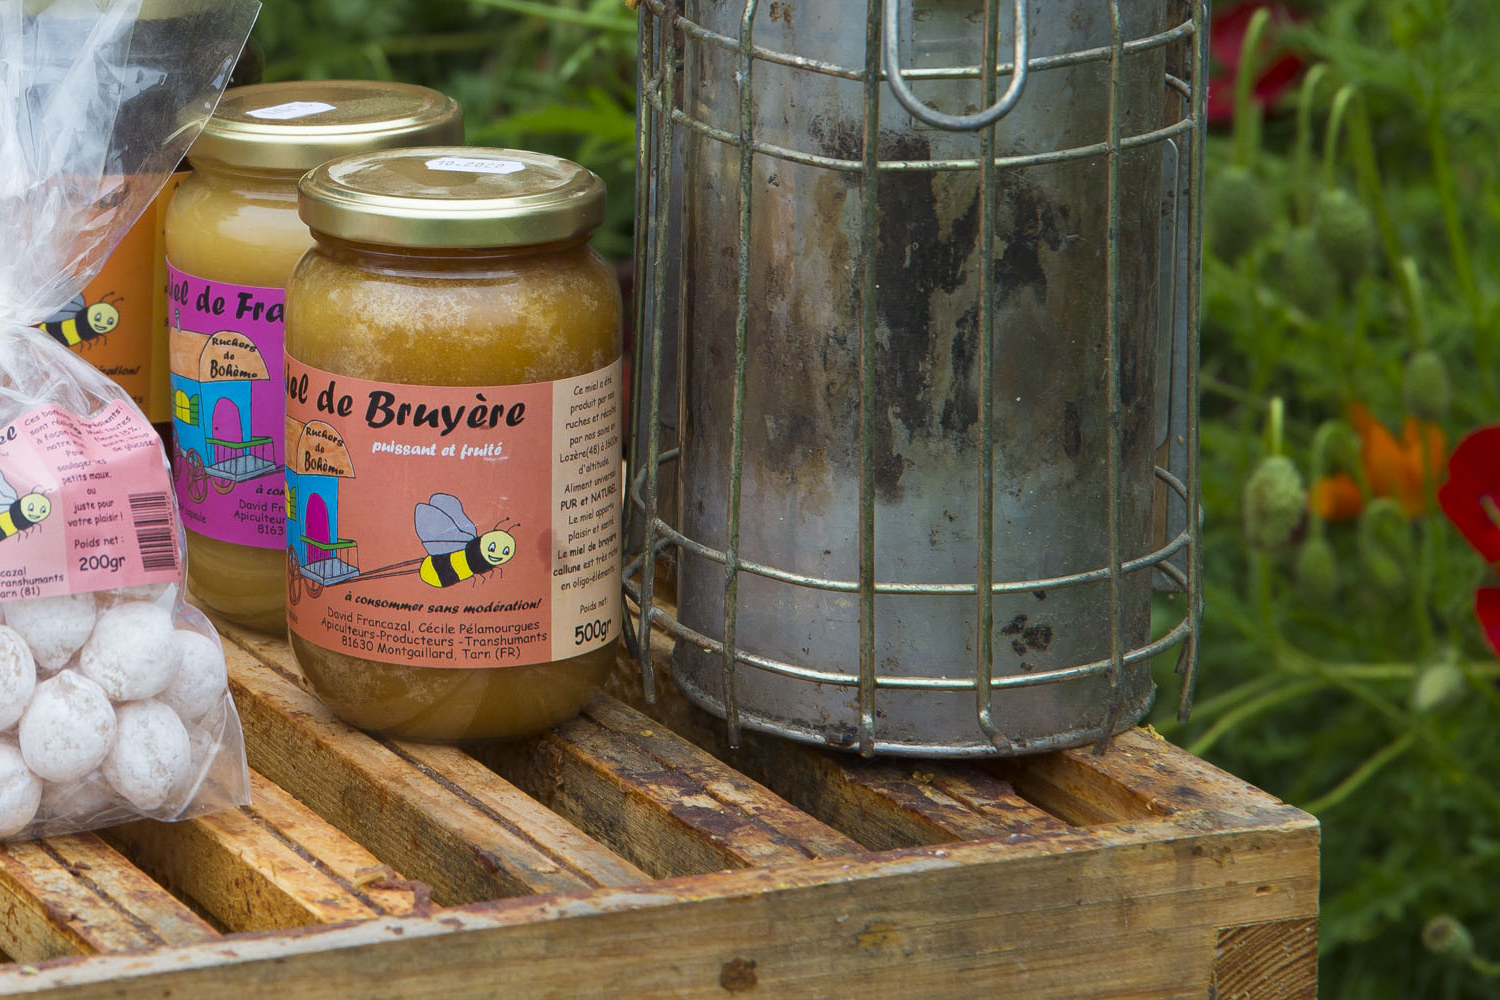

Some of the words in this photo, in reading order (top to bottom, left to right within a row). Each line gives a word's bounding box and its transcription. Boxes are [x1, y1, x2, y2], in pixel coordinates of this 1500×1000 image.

[196, 286, 226, 316] de
[212, 337, 257, 352] Ruchers
[223, 352, 235, 361] de
[210, 359, 258, 380] Bohème
[573, 385, 583, 396] Ce
[585, 380, 598, 393] miel
[286, 363, 308, 404] iel
[317, 380, 353, 417] de
[365, 390, 526, 436] Bruyère
[570, 397, 596, 416] produit
[598, 395, 607, 409] par
[24, 415, 41, 427] Ces
[30, 422, 49, 436] sont
[566, 417, 591, 430] ruches
[592, 413, 599, 423] et
[46, 439, 70, 451] notre
[305, 426, 344, 448] Ruchers
[570, 435, 582, 448] par
[585, 431, 596, 441] nos
[597, 426, 610, 438] soins
[315, 442, 325, 454] de
[372, 439, 436, 457] puissant
[440, 445, 456, 457] et
[460, 441, 503, 460] fruité
[57, 459, 92, 473] soulager
[304, 451, 345, 475] Bohème
[61, 472, 88, 486] petits
[565, 480, 592, 494] Aliment
[86, 487, 96, 496] ou
[560, 498, 577, 511] PUR
[580, 496, 588, 506] et
[591, 483, 617, 503] NATUREL
[73, 501, 95, 514] juste
[98, 499, 115, 512] pour
[239, 499, 268, 512] David
[68, 515, 92, 528] votre
[95, 512, 119, 527] plaisir
[568, 515, 578, 525] Le
[580, 508, 594, 522] miel
[258, 524, 284, 536] 8163
[569, 528, 591, 544] plaisir
[593, 524, 599, 534] et
[74, 536, 100, 549] Poids
[557, 549, 567, 560] Le
[570, 543, 586, 557] miel
[588, 541, 596, 552] de
[79, 553, 126, 572] 200gr
[553, 564, 581, 577] callune
[583, 559, 594, 569] est
[596, 551, 607, 564] très
[20, 586, 41, 598] (81)
[561, 582, 571, 591] en
[344, 590, 352, 602] à
[355, 595, 424, 612] consommer
[427, 603, 459, 615] sans
[463, 598, 542, 615] modération!
[580, 601, 597, 614] Poids
[327, 606, 353, 623] David
[356, 613, 414, 634] Francazal,
[418, 621, 455, 634] Cécile
[459, 621, 540, 636] Pélamourgues
[575, 618, 612, 645] 500gr
[341, 635, 374, 651] 81630
[377, 643, 457, 661] Montgaillard,
[462, 648, 491, 659] Tarn
[495, 646, 521, 660] (FR)
